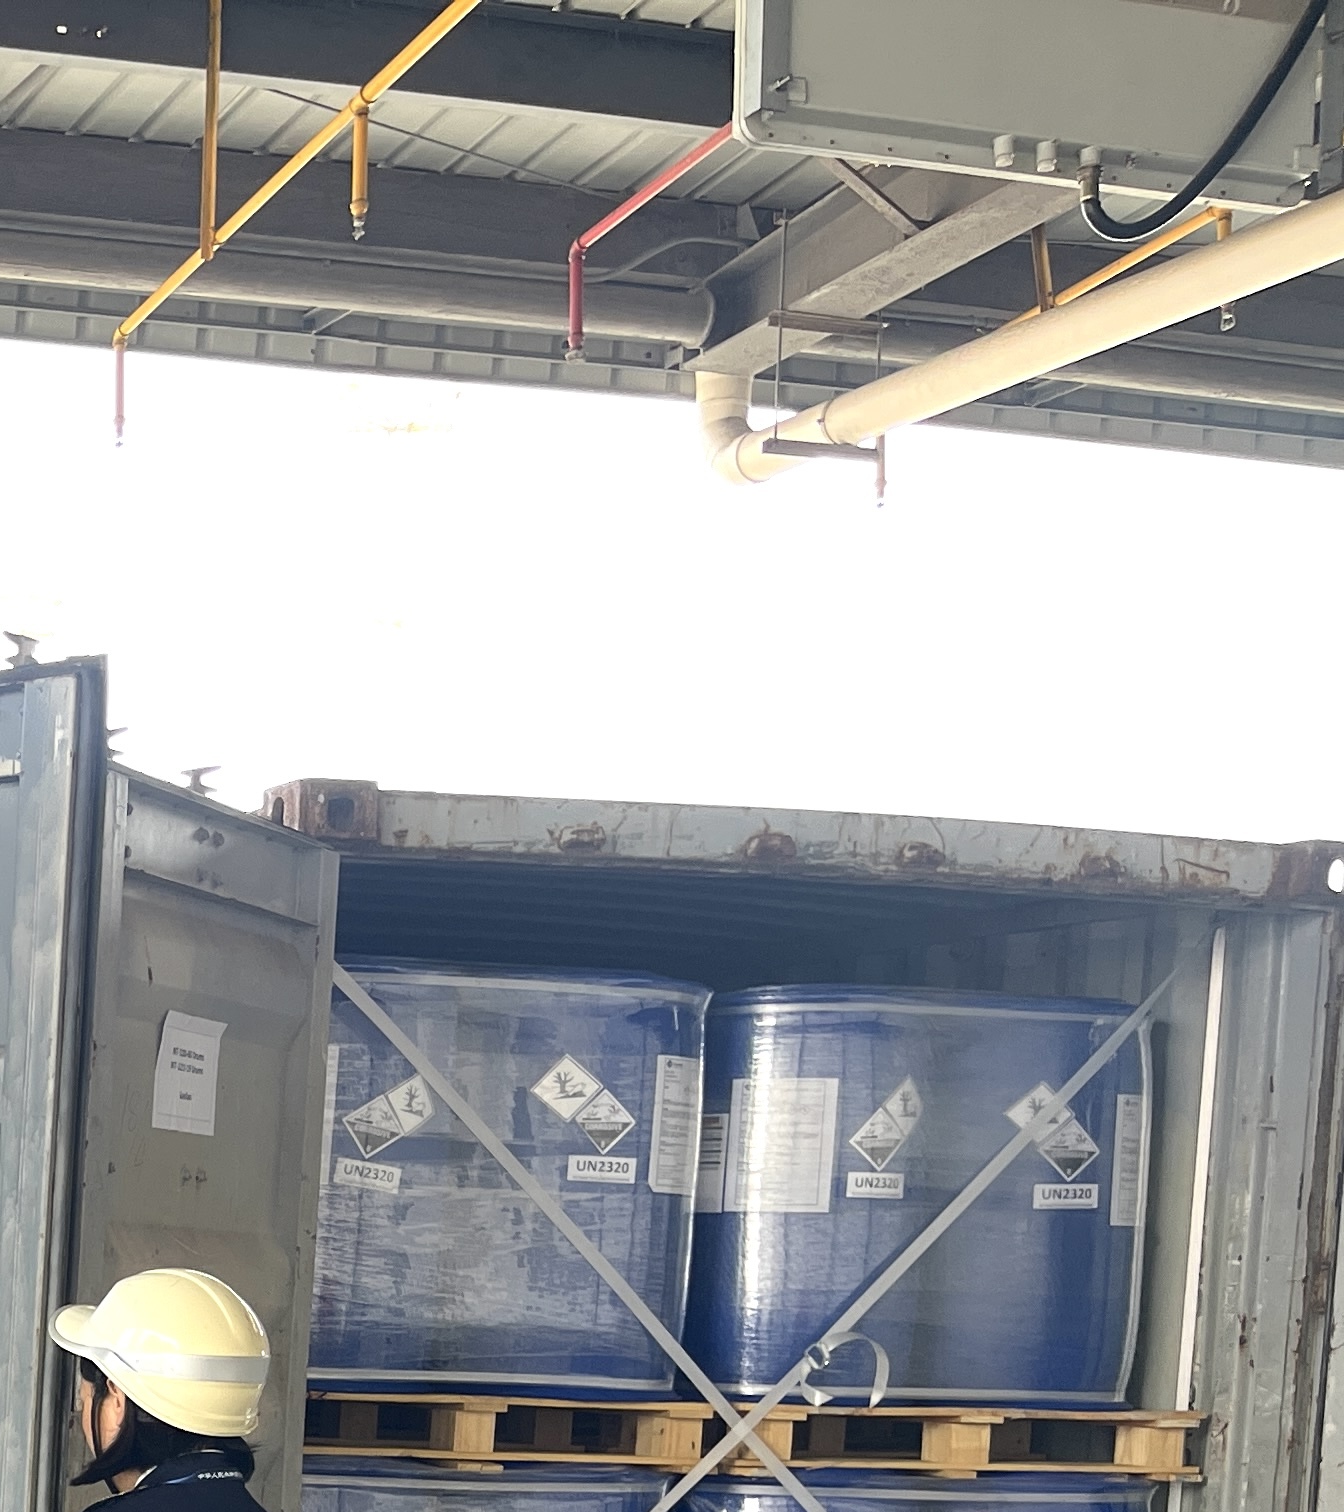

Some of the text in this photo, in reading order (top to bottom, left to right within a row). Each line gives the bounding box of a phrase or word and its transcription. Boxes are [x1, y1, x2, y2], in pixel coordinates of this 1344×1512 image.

[344, 1163, 394, 1183] UN2320
[576, 1160, 629, 1174] UN2320
[855, 1177, 899, 1189] UN2320
[1041, 1188, 1092, 1200] UN2320
